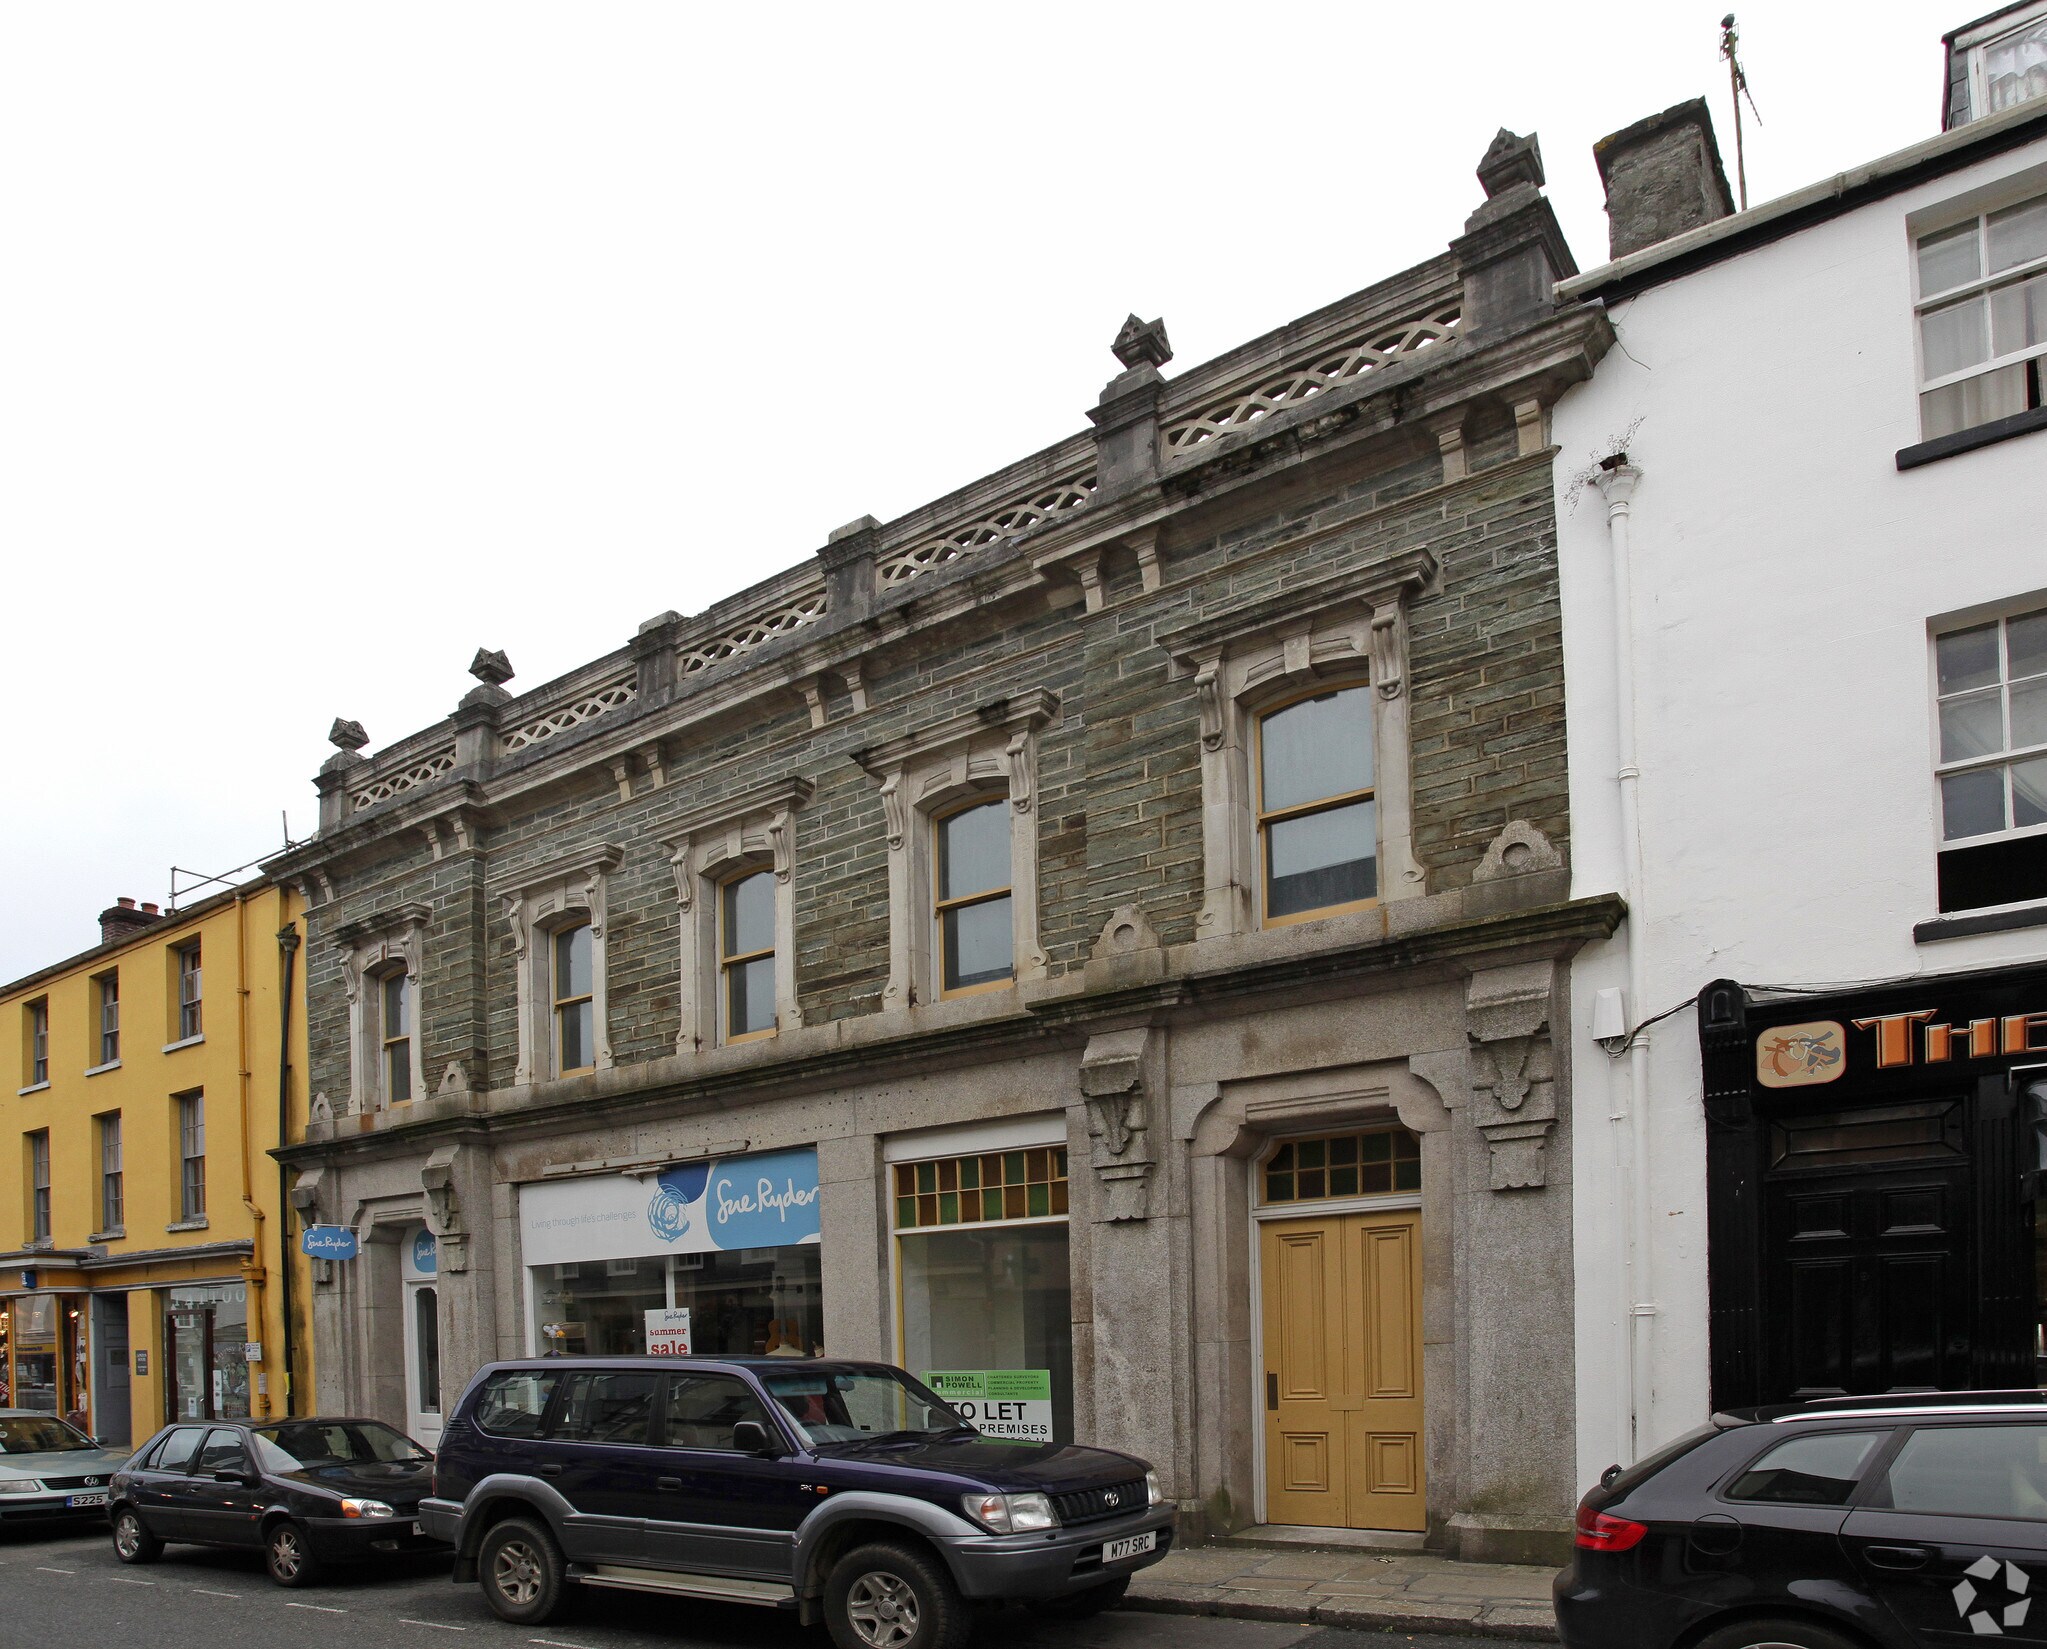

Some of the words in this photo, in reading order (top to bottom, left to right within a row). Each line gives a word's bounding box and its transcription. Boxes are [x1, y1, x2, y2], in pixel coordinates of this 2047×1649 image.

[716, 1178, 757, 1224] Sue
[757, 1178, 819, 1223] Ryder
[531, 1219, 551, 1229] Living
[552, 1215, 580, 1227] through
[581, 1213, 596, 1223] life's
[597, 1210, 637, 1222] challenges
[307, 1234, 326, 1249] Sue
[325, 1236, 352, 1251] Ryder
[416, 1241, 430, 1260] Sue
[173, 1289, 246, 1306] TATTOO
[664, 1310, 673, 1321] Sue
[649, 1328, 687, 1336] summer
[651, 1340, 688, 1354] sale
[984, 1402, 1027, 1420] LET
[979, 1423, 1048, 1434] PREMISES
[73, 1496, 103, 1505] S225
[1111, 1541, 1130, 1558] M77
[1132, 1535, 1150, 1552] SRC
